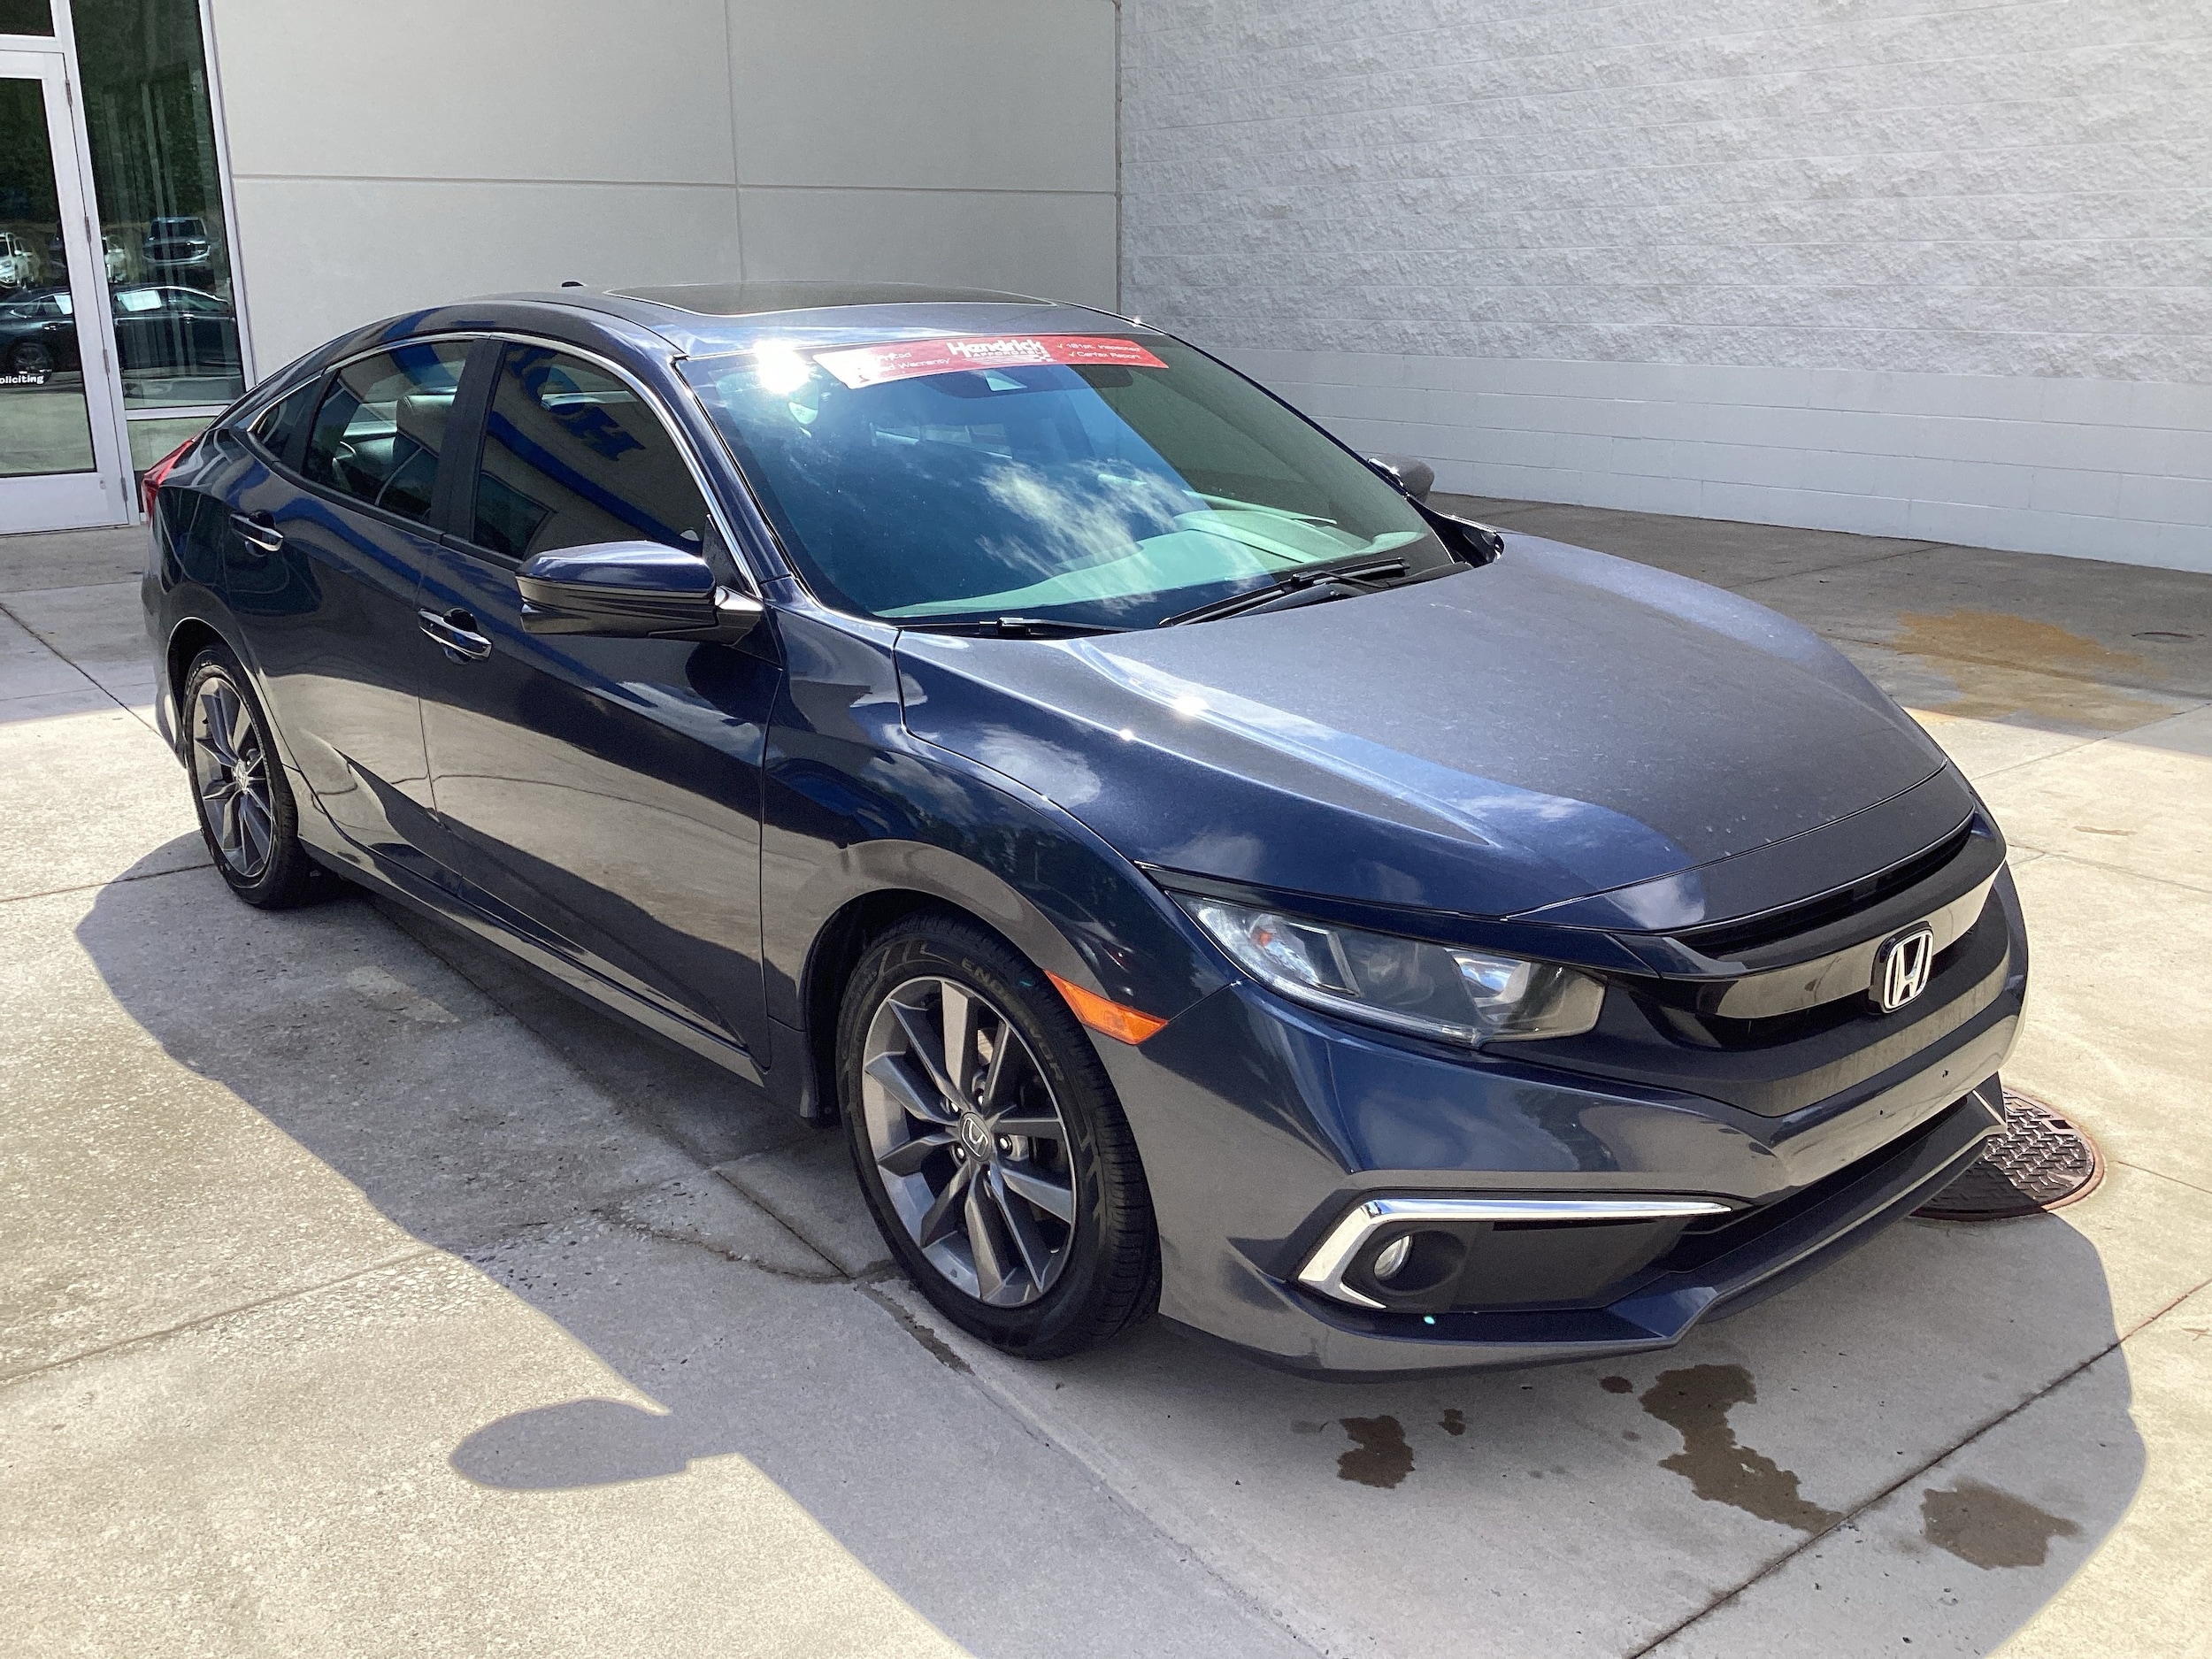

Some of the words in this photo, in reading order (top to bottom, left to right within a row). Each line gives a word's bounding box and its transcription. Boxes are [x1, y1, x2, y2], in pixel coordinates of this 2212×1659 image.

[947, 339, 1045, 357] Hendrick
[897, 357, 950, 369] Warranty
[0, 374, 44, 384] oliciting
